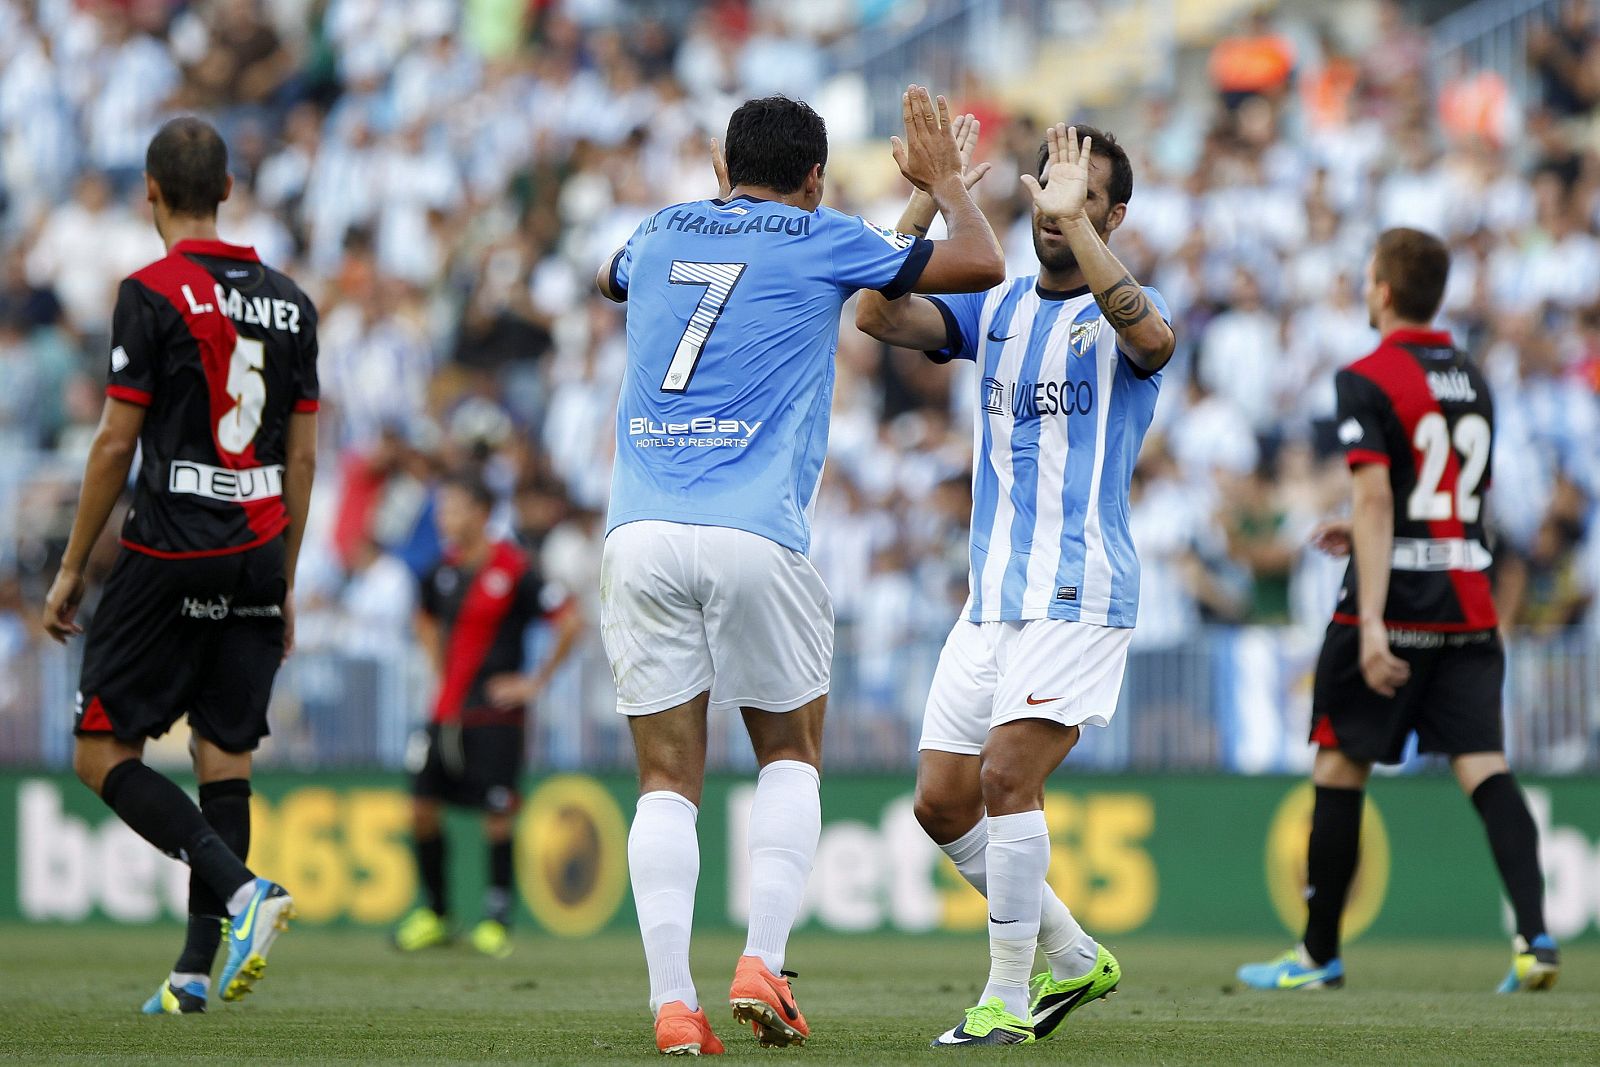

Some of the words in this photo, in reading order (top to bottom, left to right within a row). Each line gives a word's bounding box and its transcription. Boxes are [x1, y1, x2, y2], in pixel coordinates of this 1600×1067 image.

[181, 284, 214, 314] L.
[659, 259, 748, 393] 7
[217, 334, 266, 454] 5
[1011, 380, 1093, 417] UNESCO
[629, 416, 763, 438] BlueBay
[636, 437, 675, 448] HOTELS
[678, 437, 686, 447] &
[688, 438, 748, 448] RESORTS
[1407, 411, 1491, 523] 22
